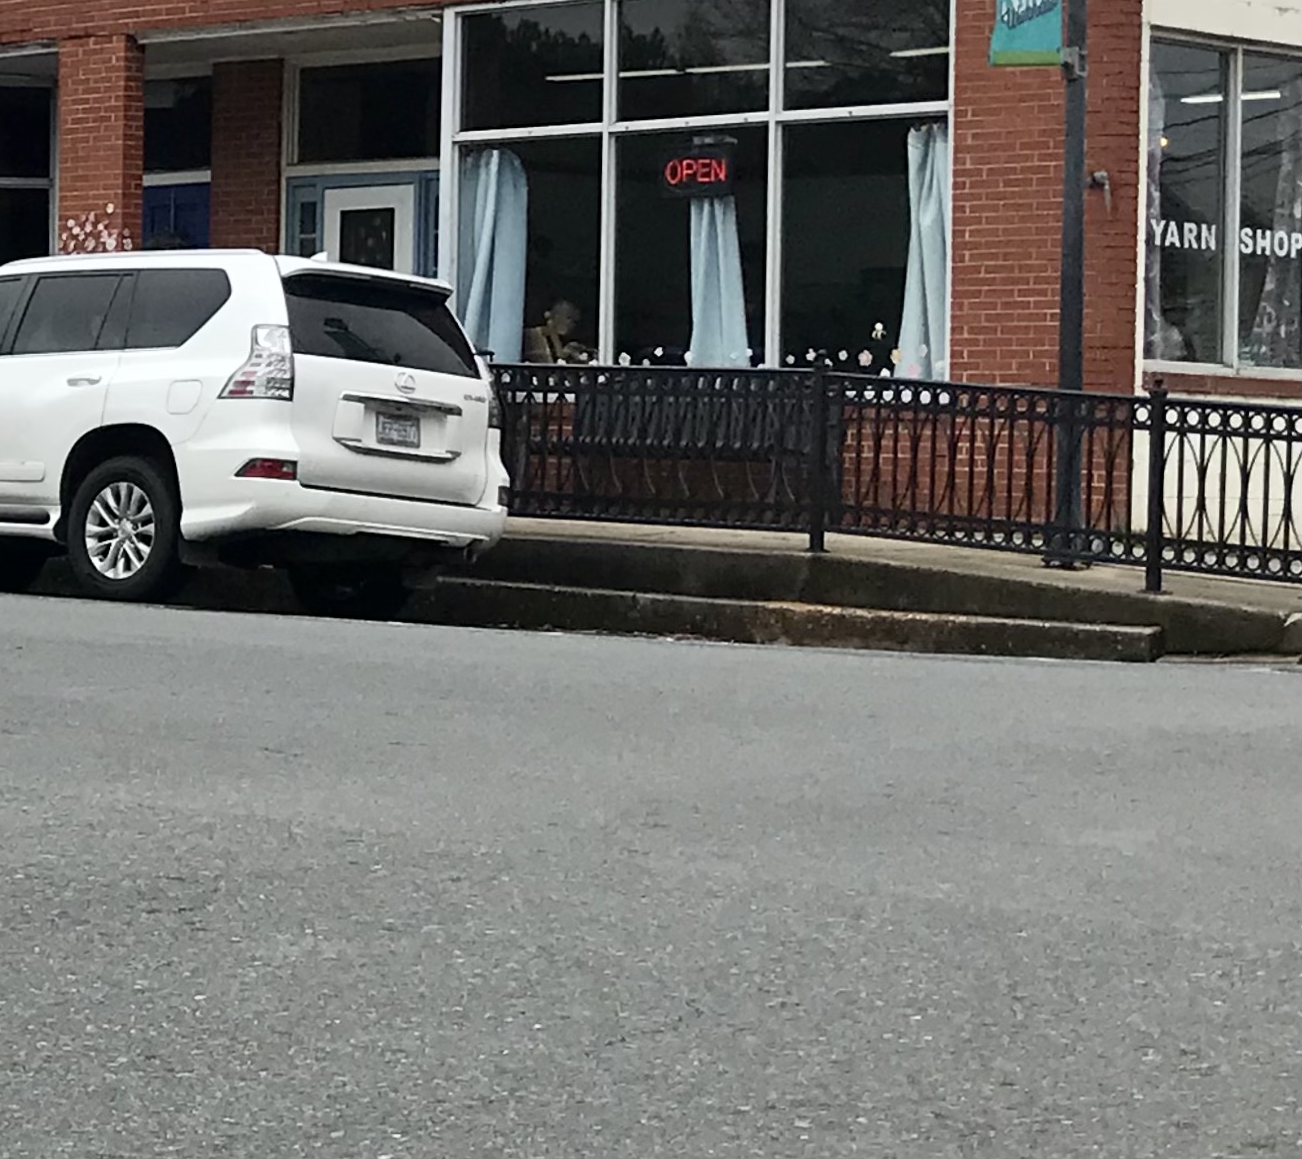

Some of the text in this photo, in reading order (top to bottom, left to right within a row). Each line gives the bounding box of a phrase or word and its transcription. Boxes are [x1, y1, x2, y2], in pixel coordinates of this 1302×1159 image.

[665, 159, 726, 185] OPEN
[1150, 218, 1302, 259] YARN SHOP
